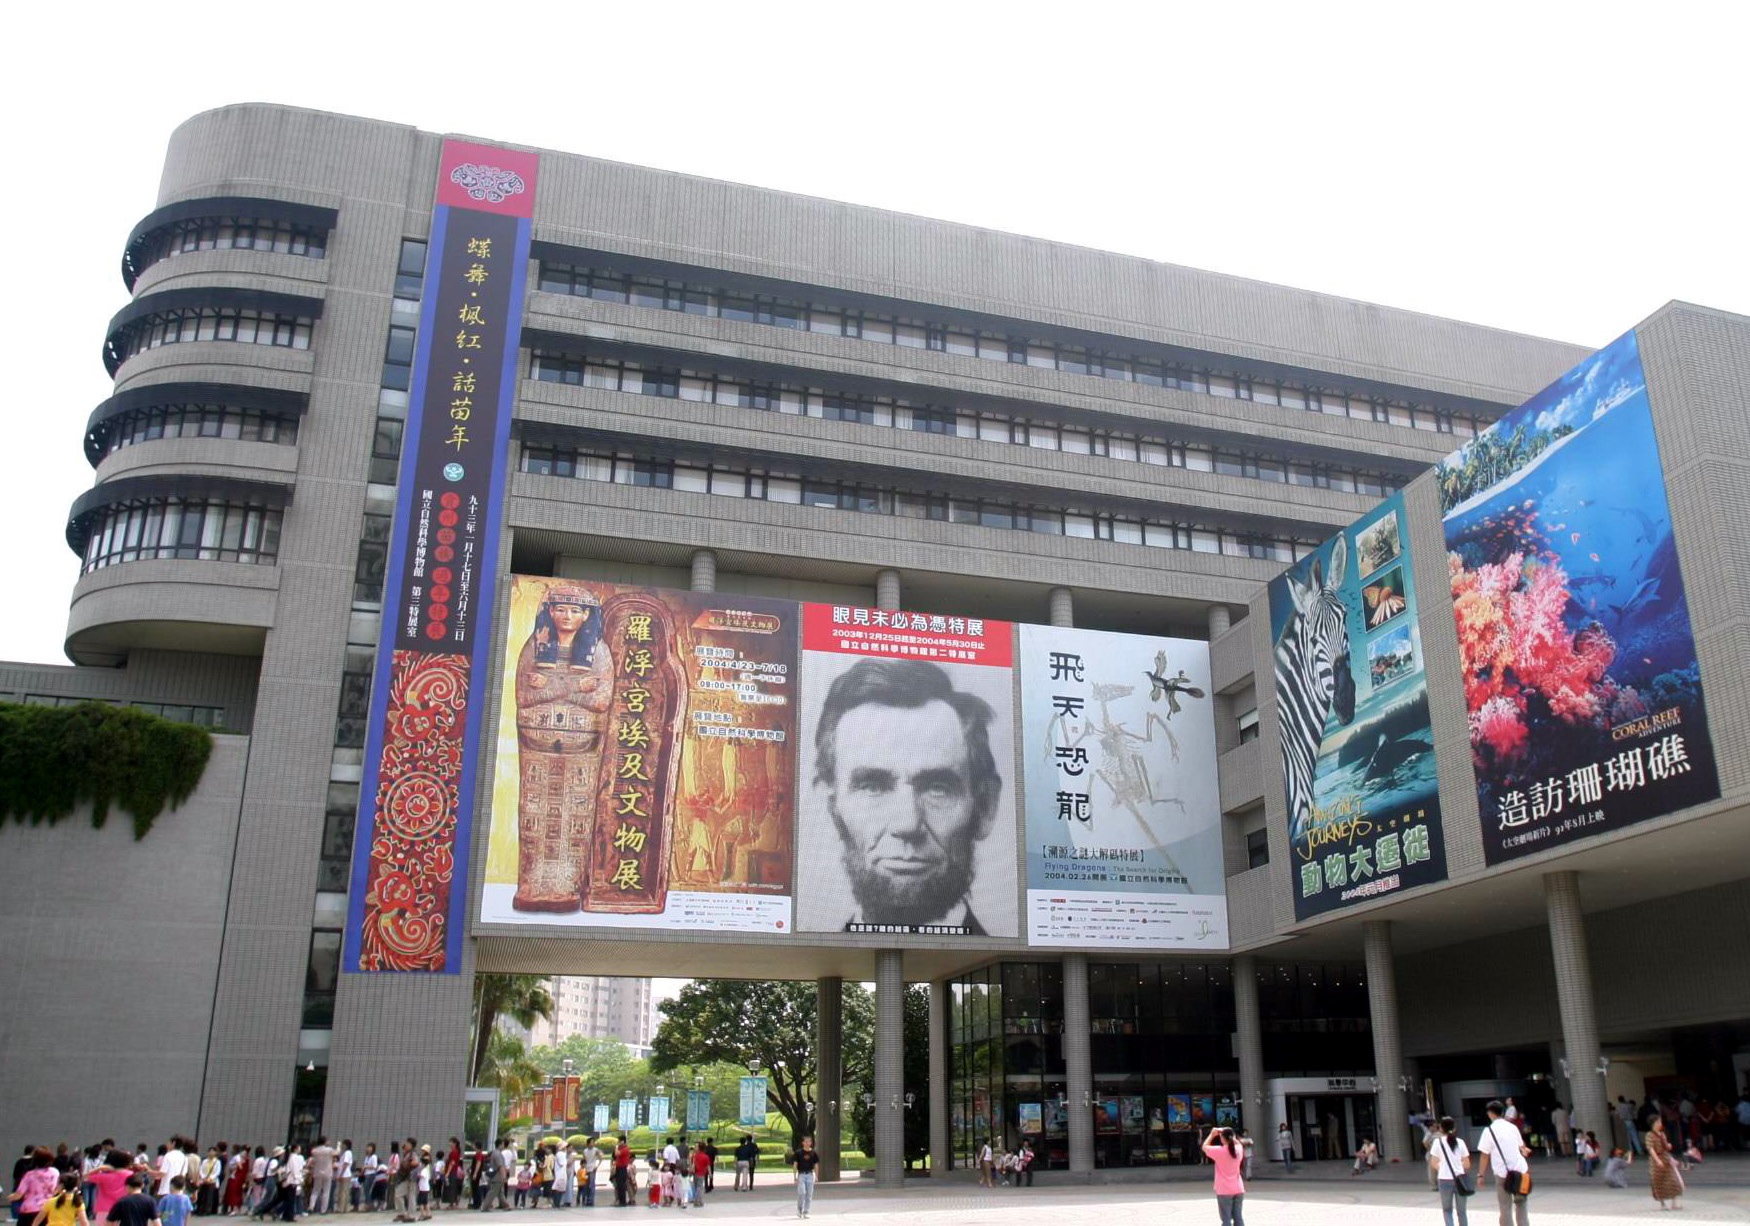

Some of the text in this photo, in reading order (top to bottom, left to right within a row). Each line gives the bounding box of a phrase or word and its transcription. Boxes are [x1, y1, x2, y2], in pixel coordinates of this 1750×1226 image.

[406, 489, 433, 638] 國立自然科學博物館 第三特展室
[833, 606, 984, 637] 眼見未必為憑特展
[698, 725, 785, 741] 國立自然科學博物館
[1049, 652, 1092, 822] 飛天恐龍
[1612, 722, 1650, 741] CORAL
[1652, 706, 1682, 726] REEF
[1638, 718, 1682, 739] ADVENTURE
[611, 615, 654, 891] 羅浮宮埃及文物展
[1497, 733, 1692, 831] 造訪珊瑚礁
[1295, 812, 1373, 860] JOURNEYS
[1044, 863, 1069, 871] Flying
[1300, 824, 1431, 898] 動物大遷徙
